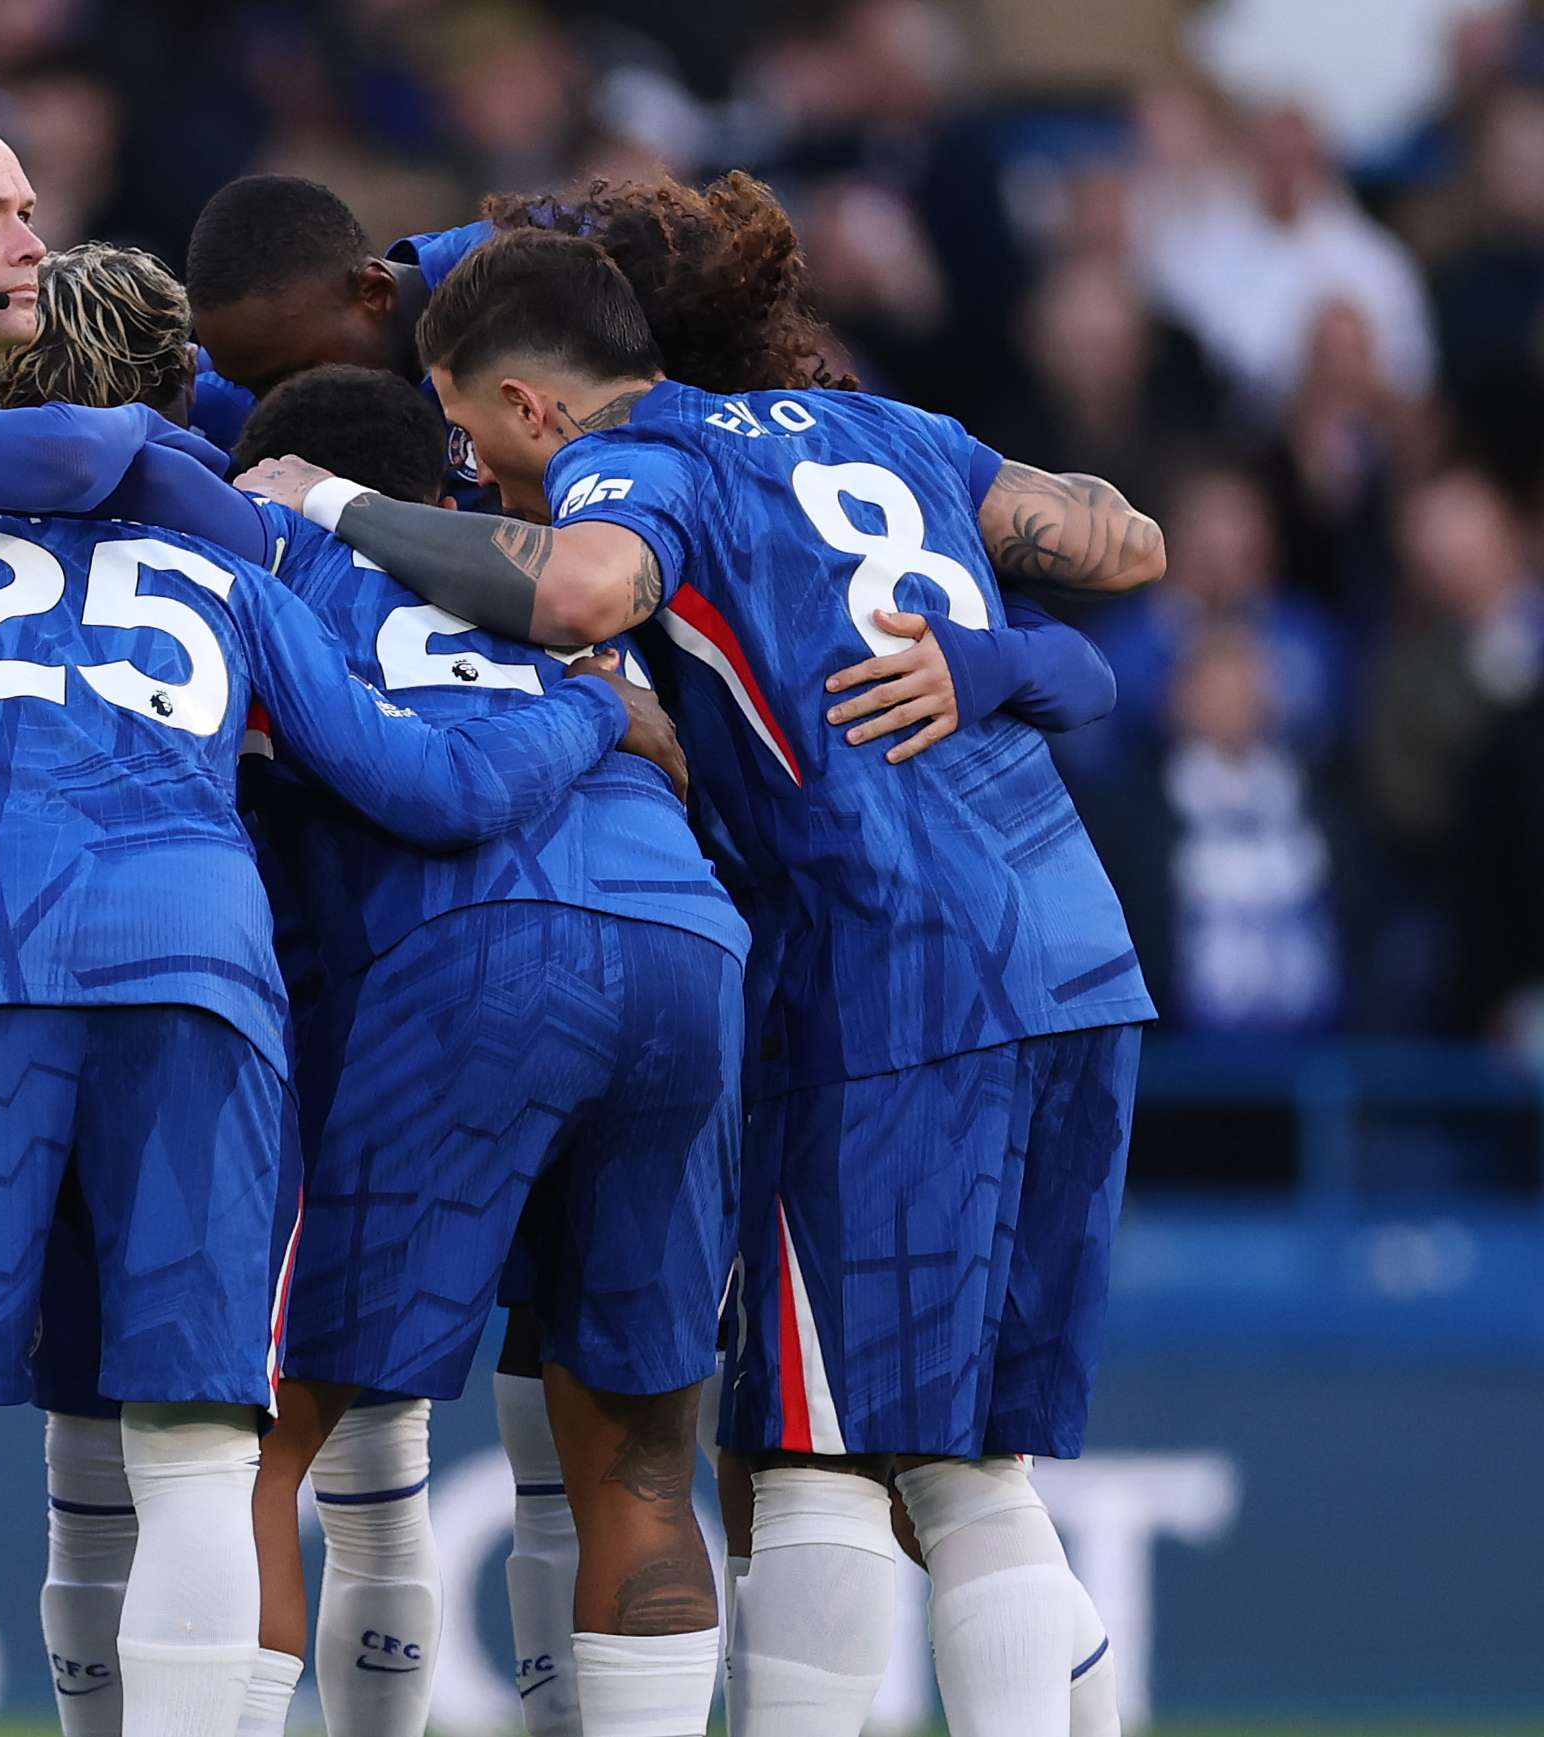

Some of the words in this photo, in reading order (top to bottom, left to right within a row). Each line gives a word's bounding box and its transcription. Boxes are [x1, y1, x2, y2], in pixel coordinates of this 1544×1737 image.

[792, 460, 991, 658] 8
[361, 1630, 421, 1660] CFC
[51, 1653, 111, 1678] CFC
